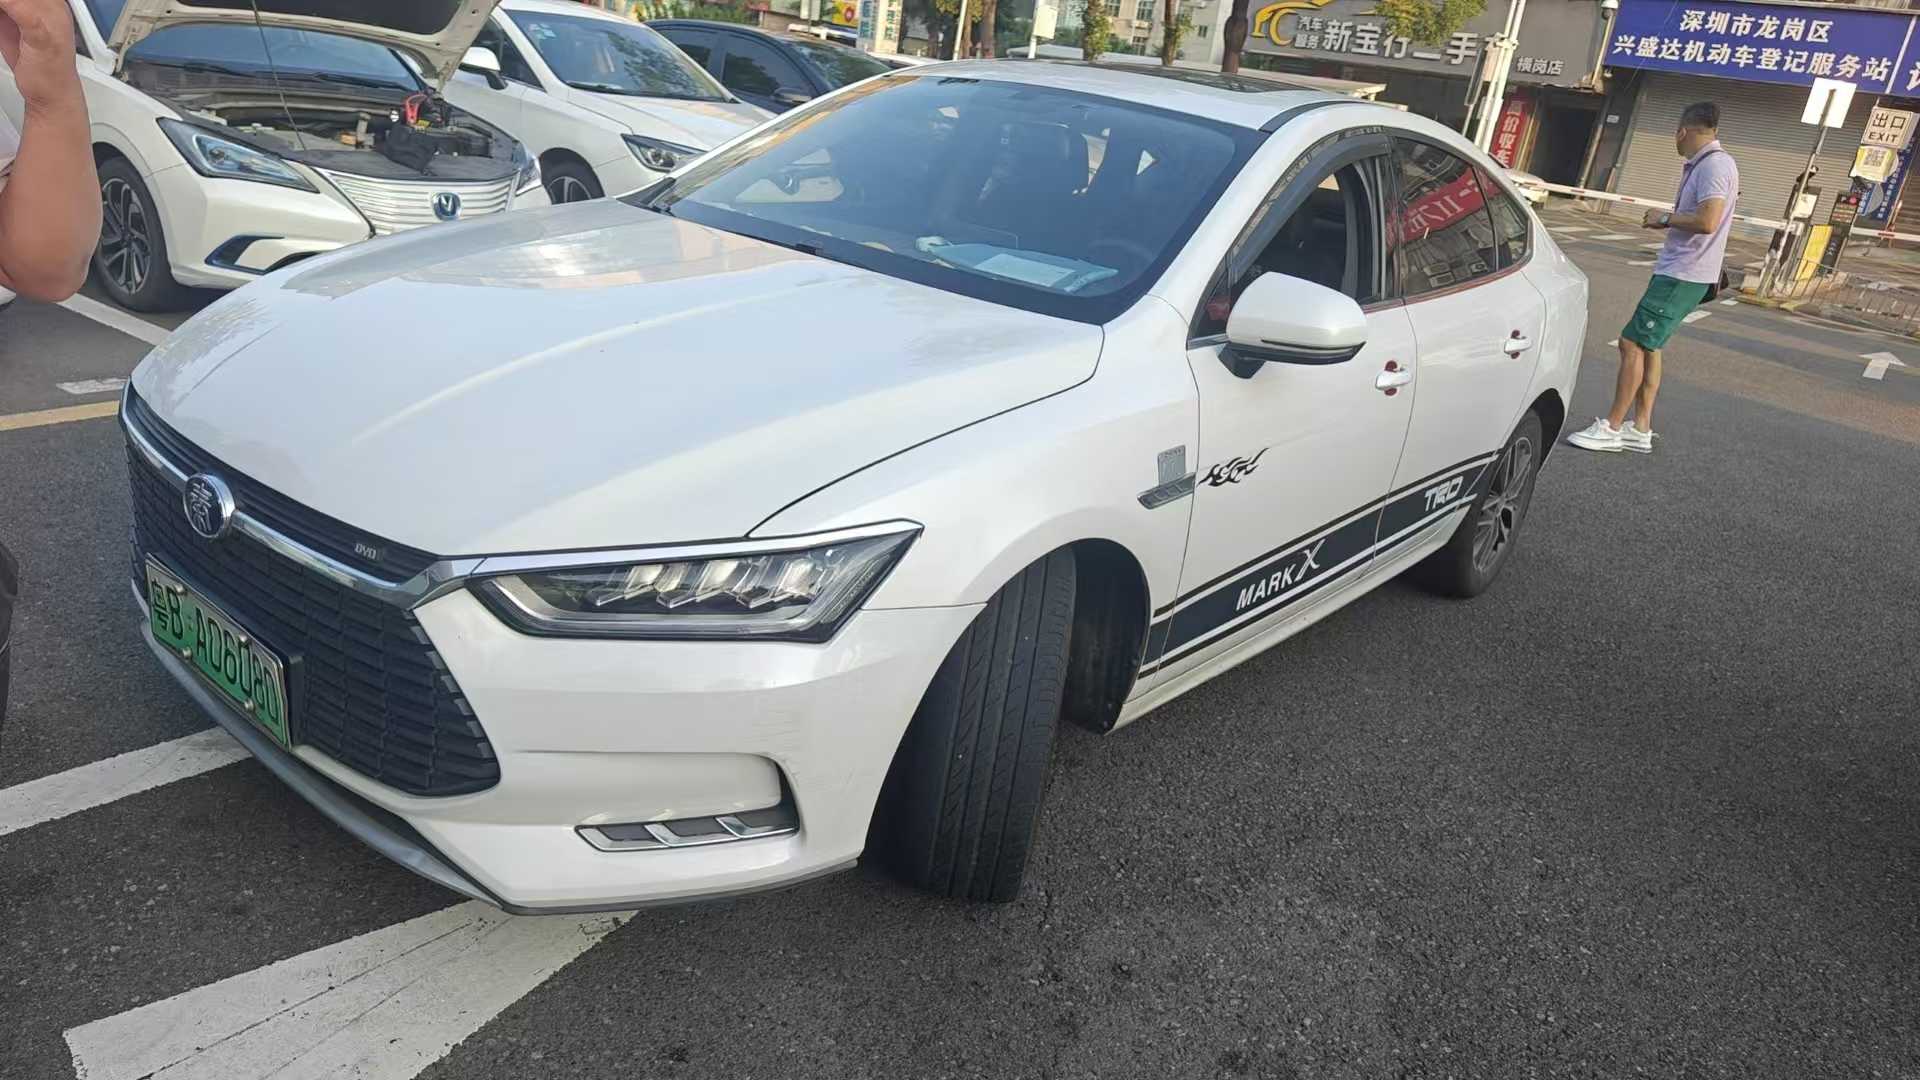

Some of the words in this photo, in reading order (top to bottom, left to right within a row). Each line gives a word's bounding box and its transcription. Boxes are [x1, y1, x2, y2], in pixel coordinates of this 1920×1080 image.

[1298, 15, 1323, 32] 汽车
[1679, 9, 1834, 44] 深圳市龙岗区
[1516, 56, 1565, 75] 横岗店
[1612, 34, 1892, 82] 兴盛达机动车登记服务站
[1872, 112, 1907, 130] 出口
[1868, 131, 1899, 143] EXIT
[1235, 563, 1297, 612] MARK
[1293, 538, 1327, 583] X
